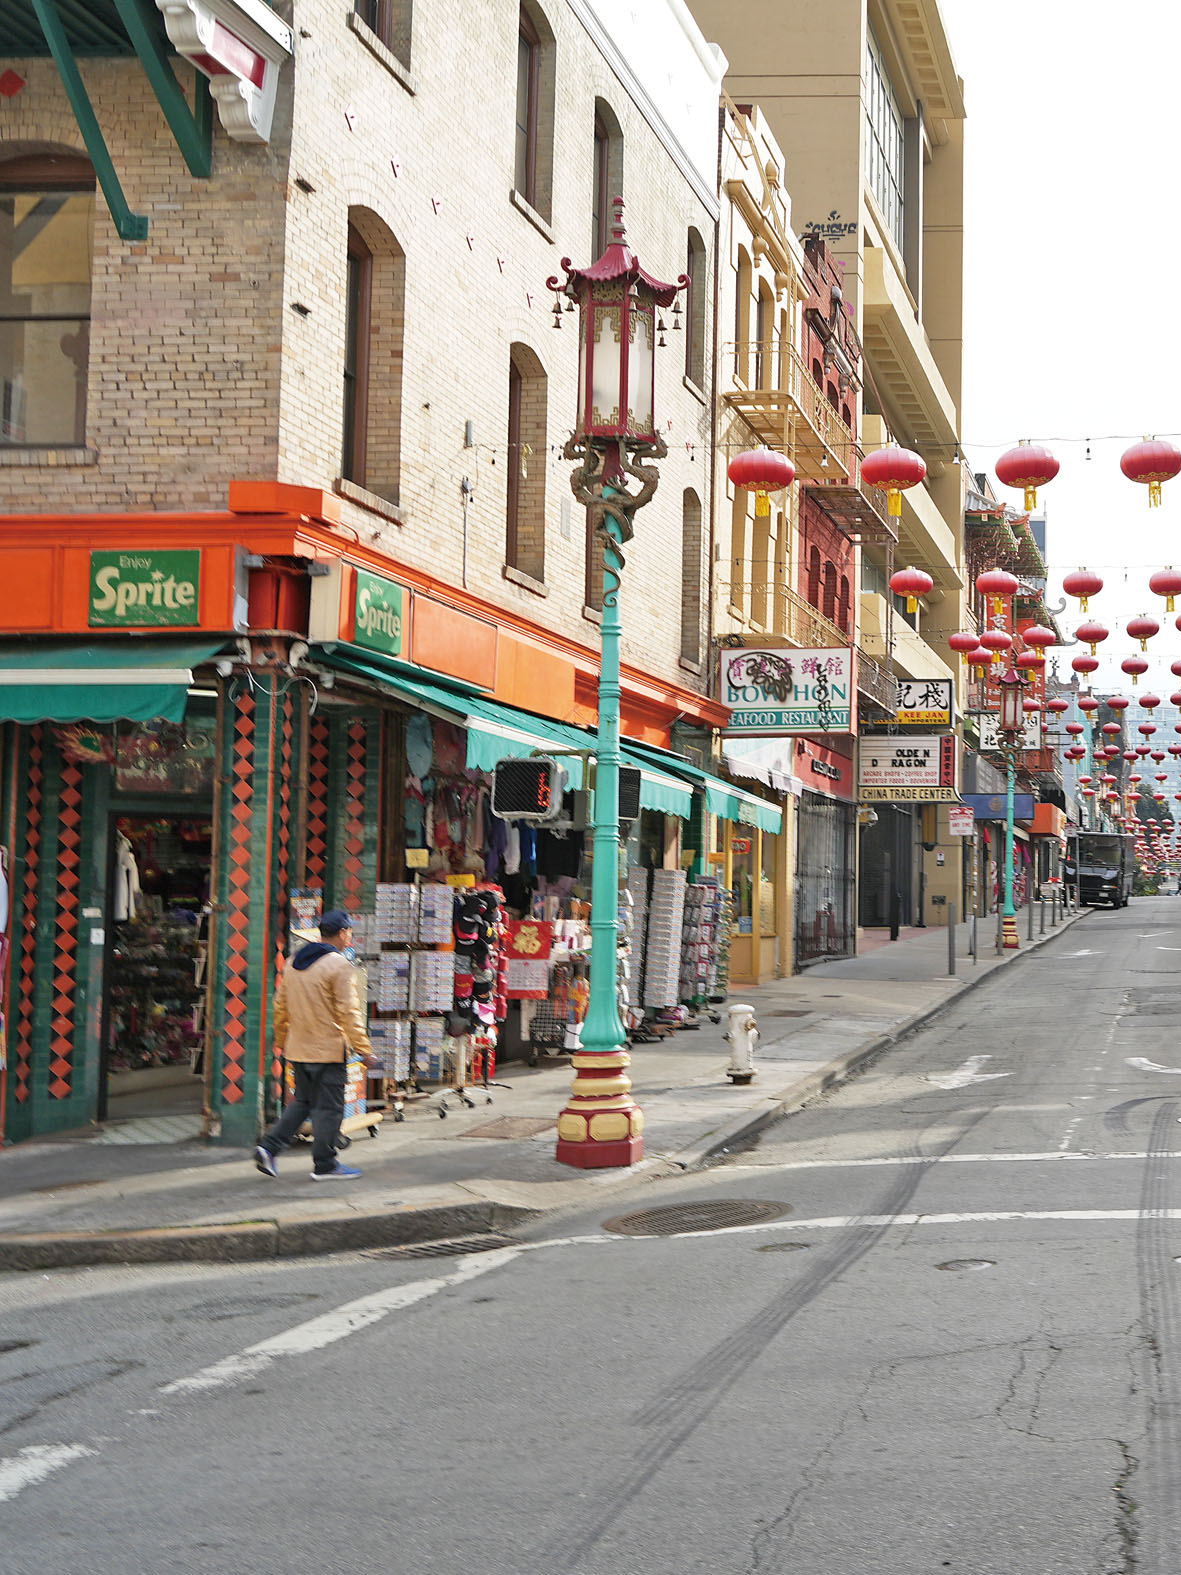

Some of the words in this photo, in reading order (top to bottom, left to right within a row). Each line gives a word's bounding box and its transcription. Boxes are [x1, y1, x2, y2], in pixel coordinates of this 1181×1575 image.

[119, 555, 152, 570] Enjoy
[92, 566, 196, 617] Sprite
[356, 587, 401, 638] Sprite
[793, 682, 847, 701] HON
[782, 711, 848, 725] RESTAURANT
[862, 788, 888, 800] CHINA
[890, 788, 917, 800] TRADE
[919, 788, 952, 799] CENTER
